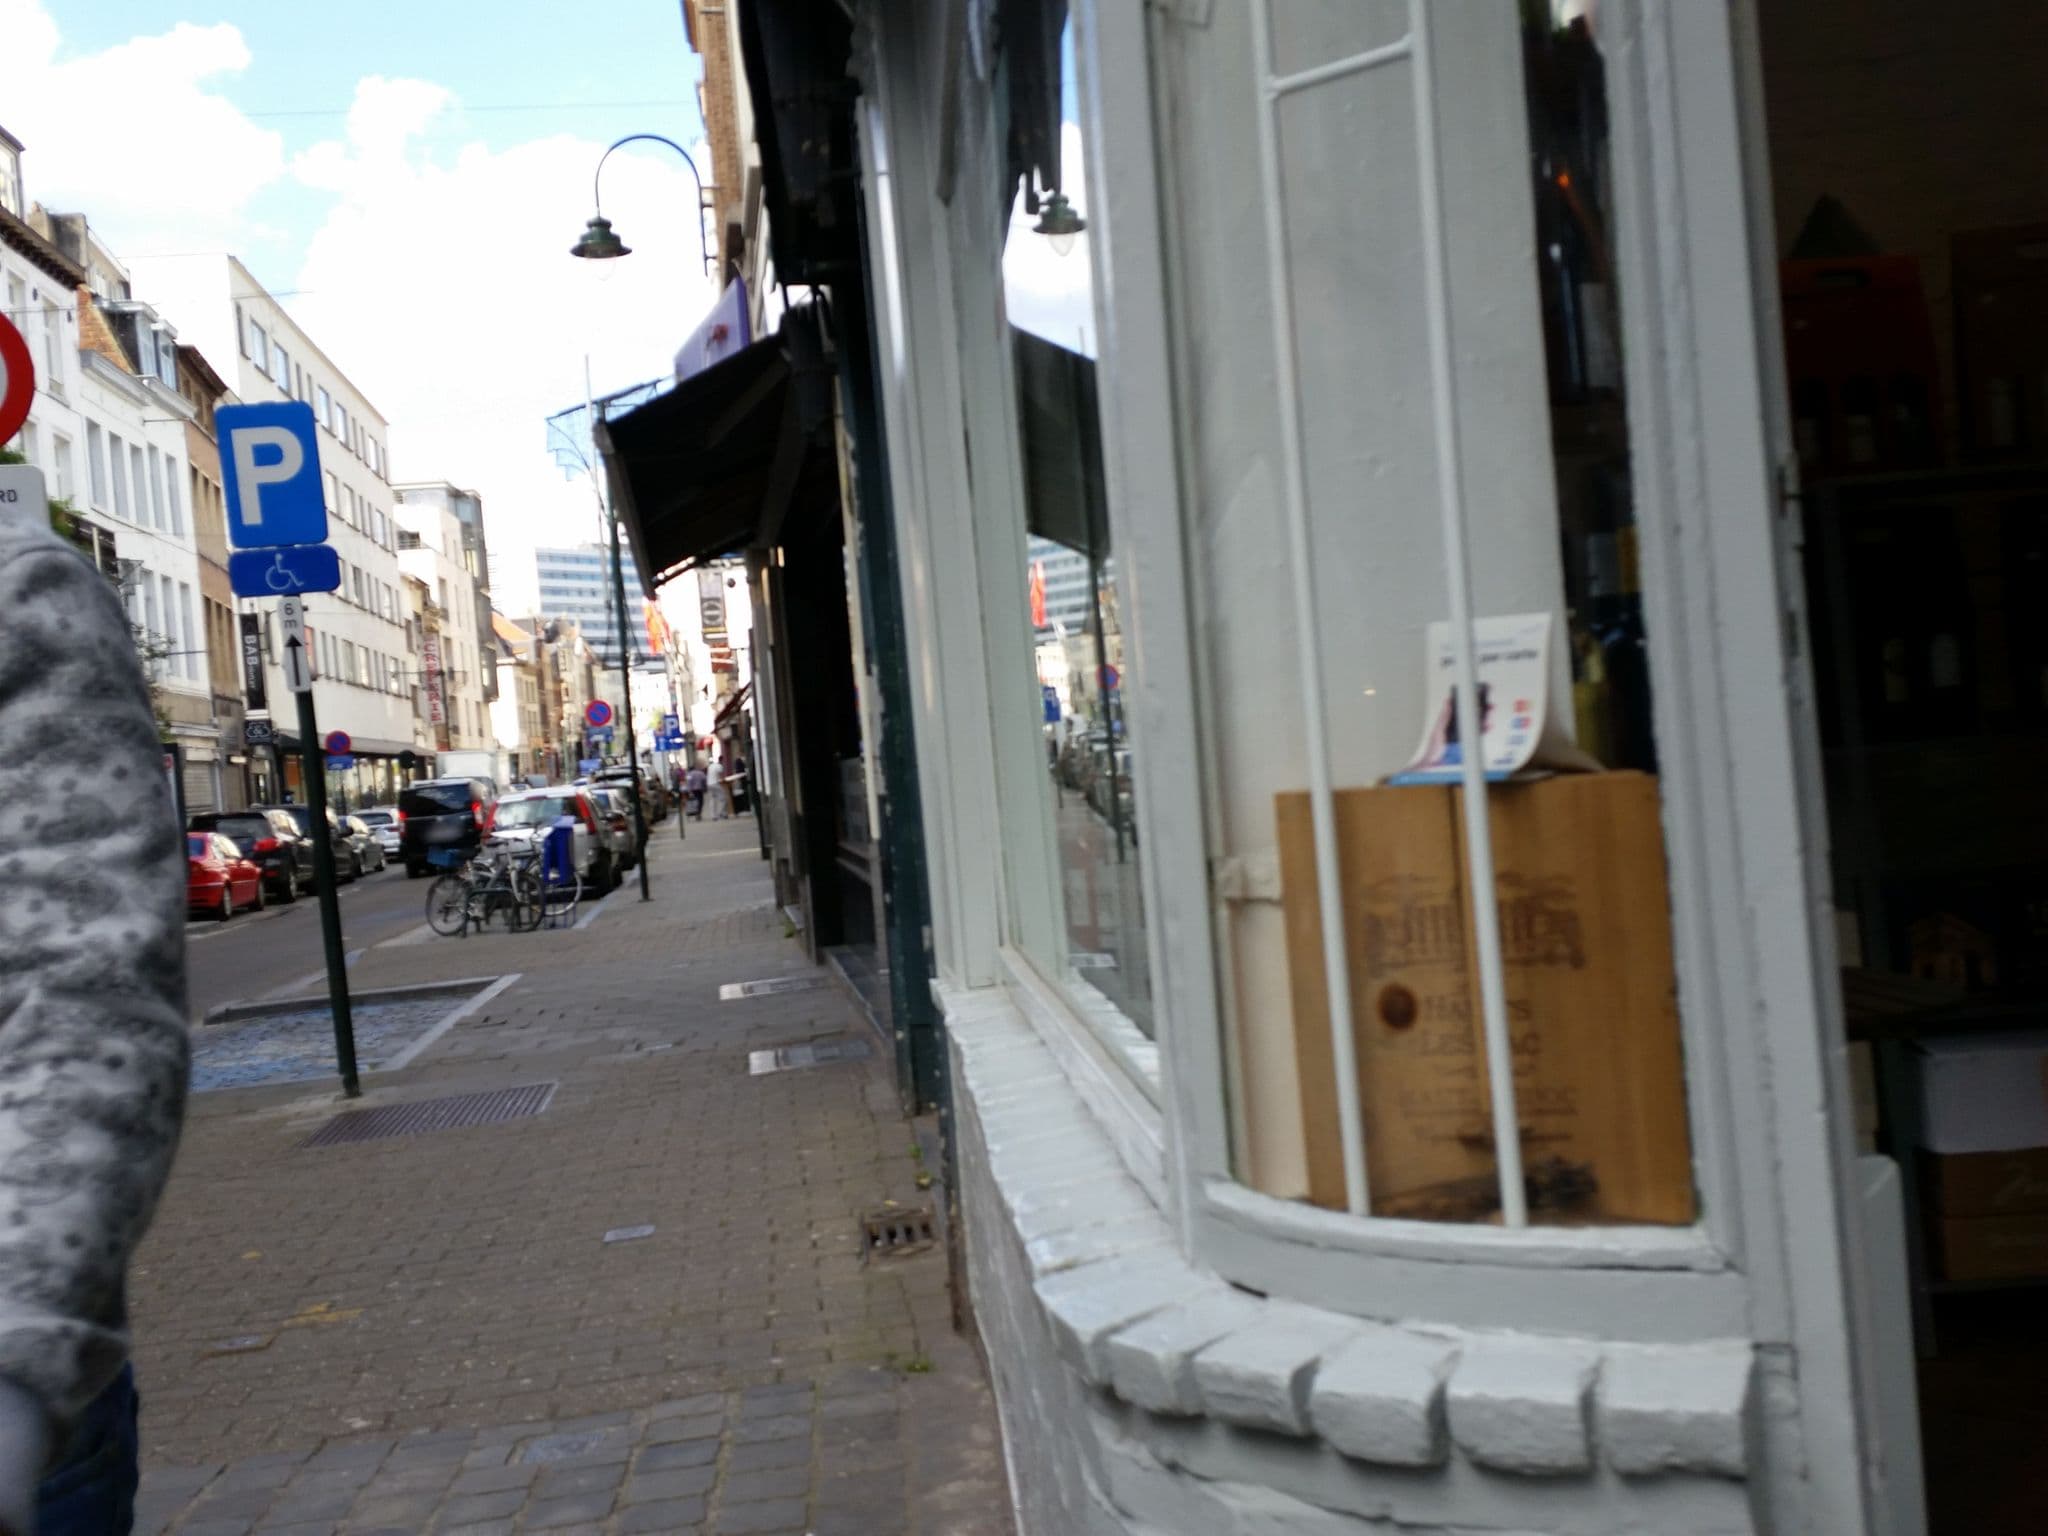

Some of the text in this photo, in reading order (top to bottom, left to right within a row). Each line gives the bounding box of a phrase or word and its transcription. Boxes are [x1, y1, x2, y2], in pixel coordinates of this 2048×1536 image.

[231, 426, 303, 526] P
[284, 602, 294, 615] 6
[284, 618, 297, 629] m
